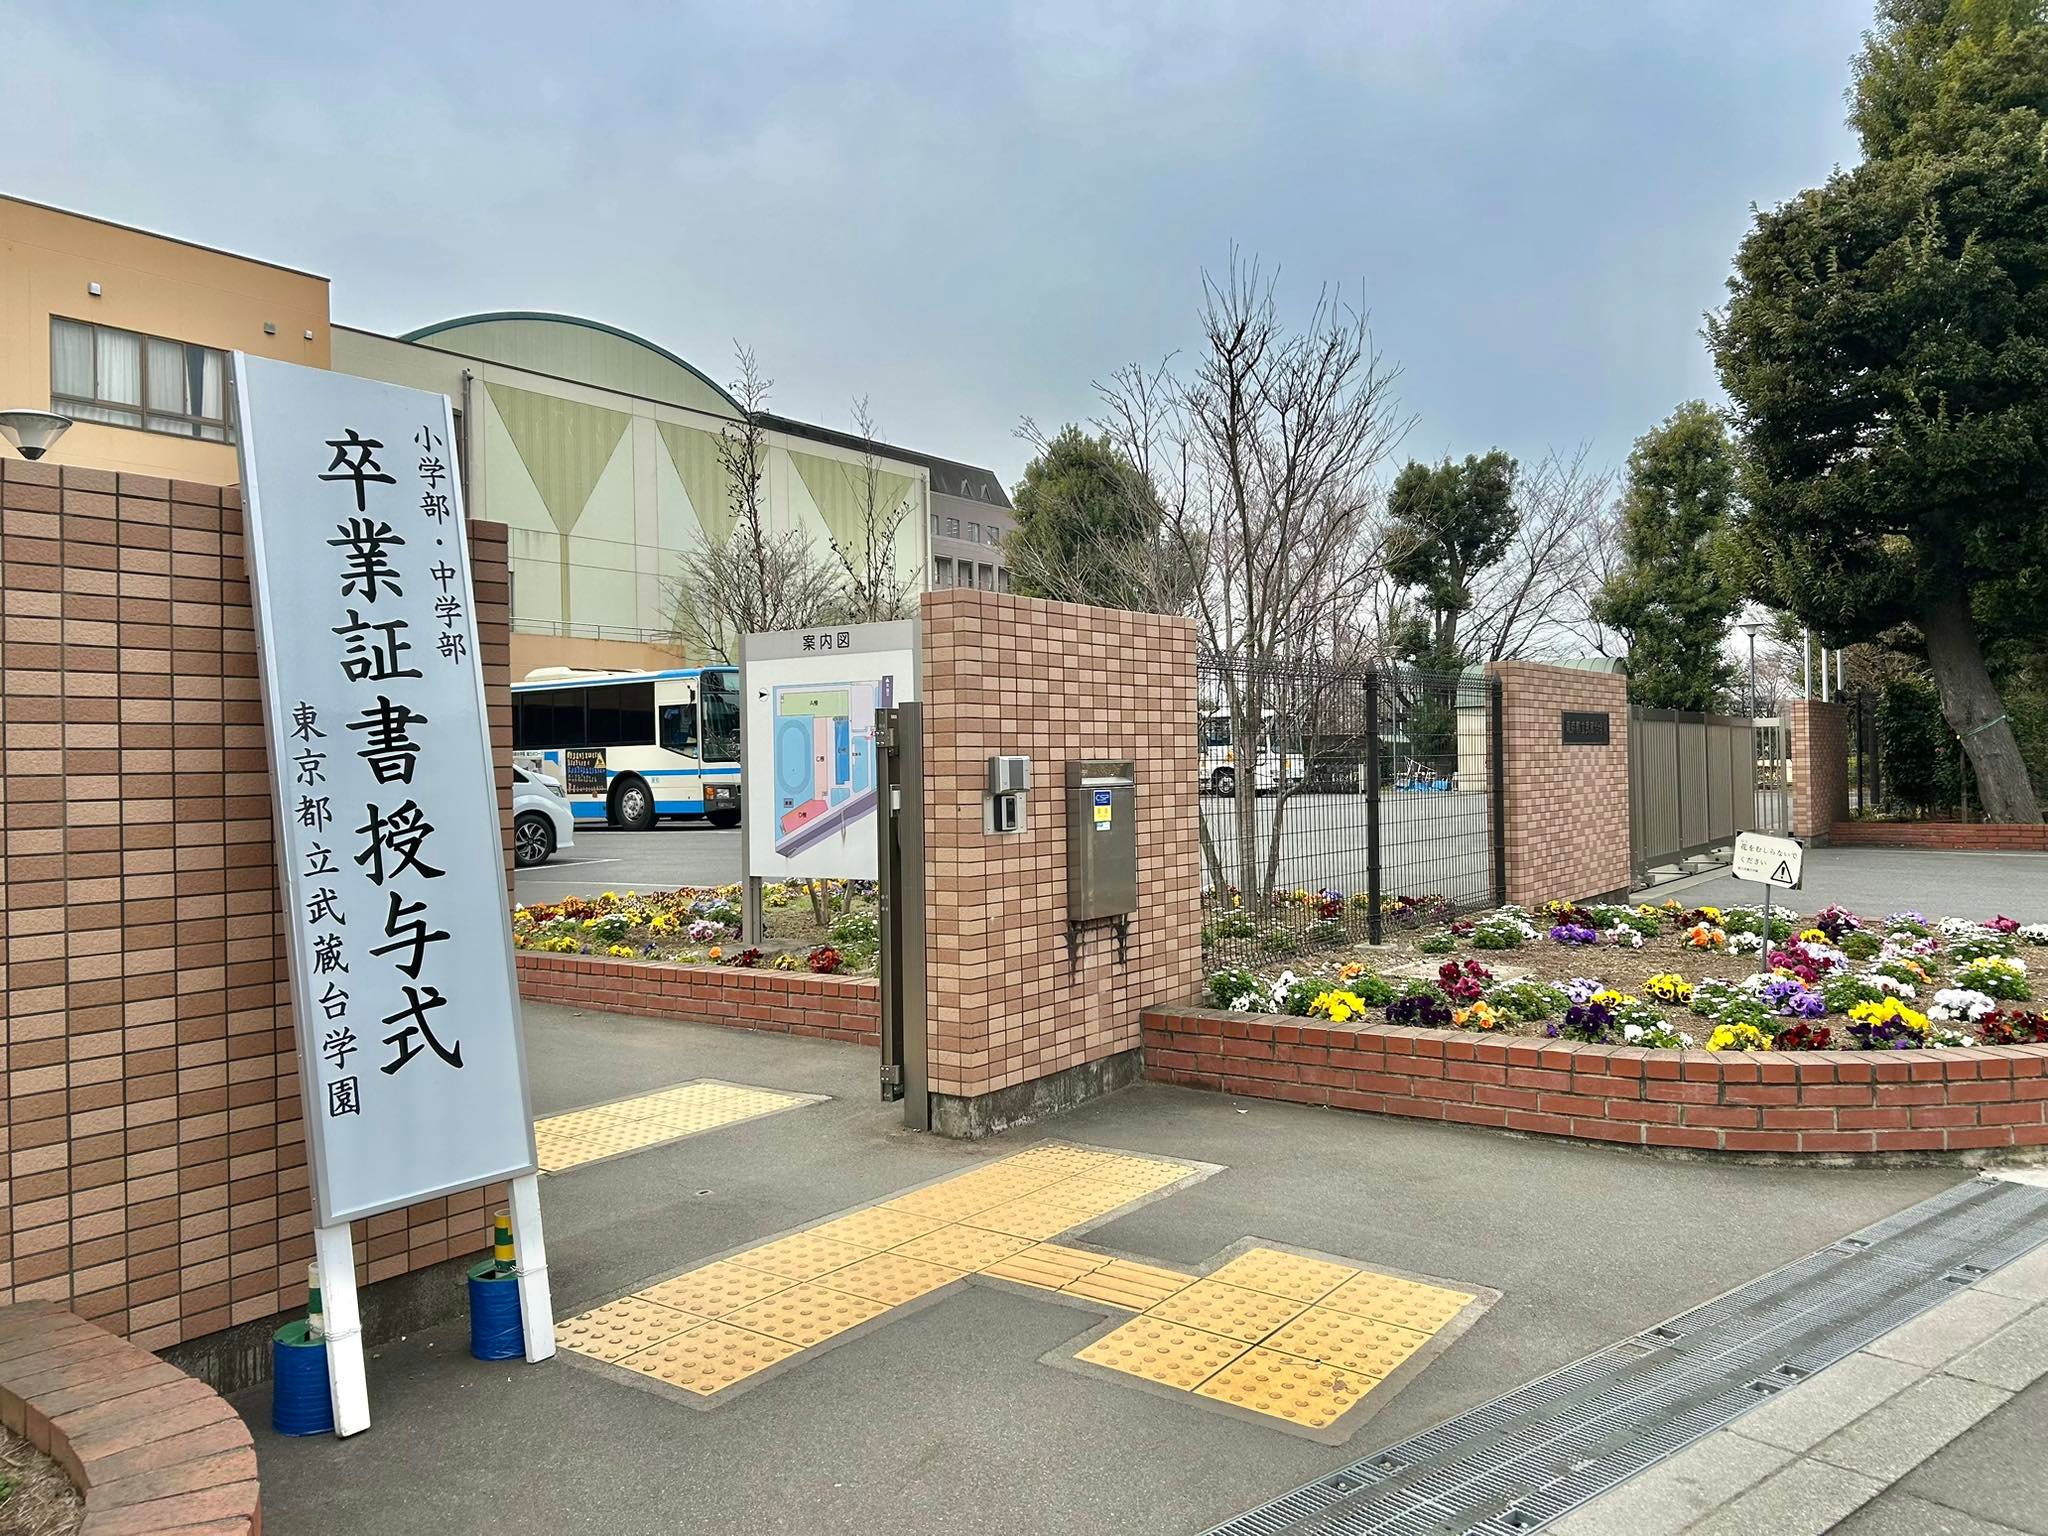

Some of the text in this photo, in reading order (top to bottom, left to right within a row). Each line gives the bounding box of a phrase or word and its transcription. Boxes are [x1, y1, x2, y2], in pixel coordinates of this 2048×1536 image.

[413, 425, 467, 665] 小学部・中学部
[802, 631, 850, 651] 案内図
[291, 700, 362, 1117] 東京都立武蔵台学園
[317, 428, 464, 1076] 卒業証書授与式
